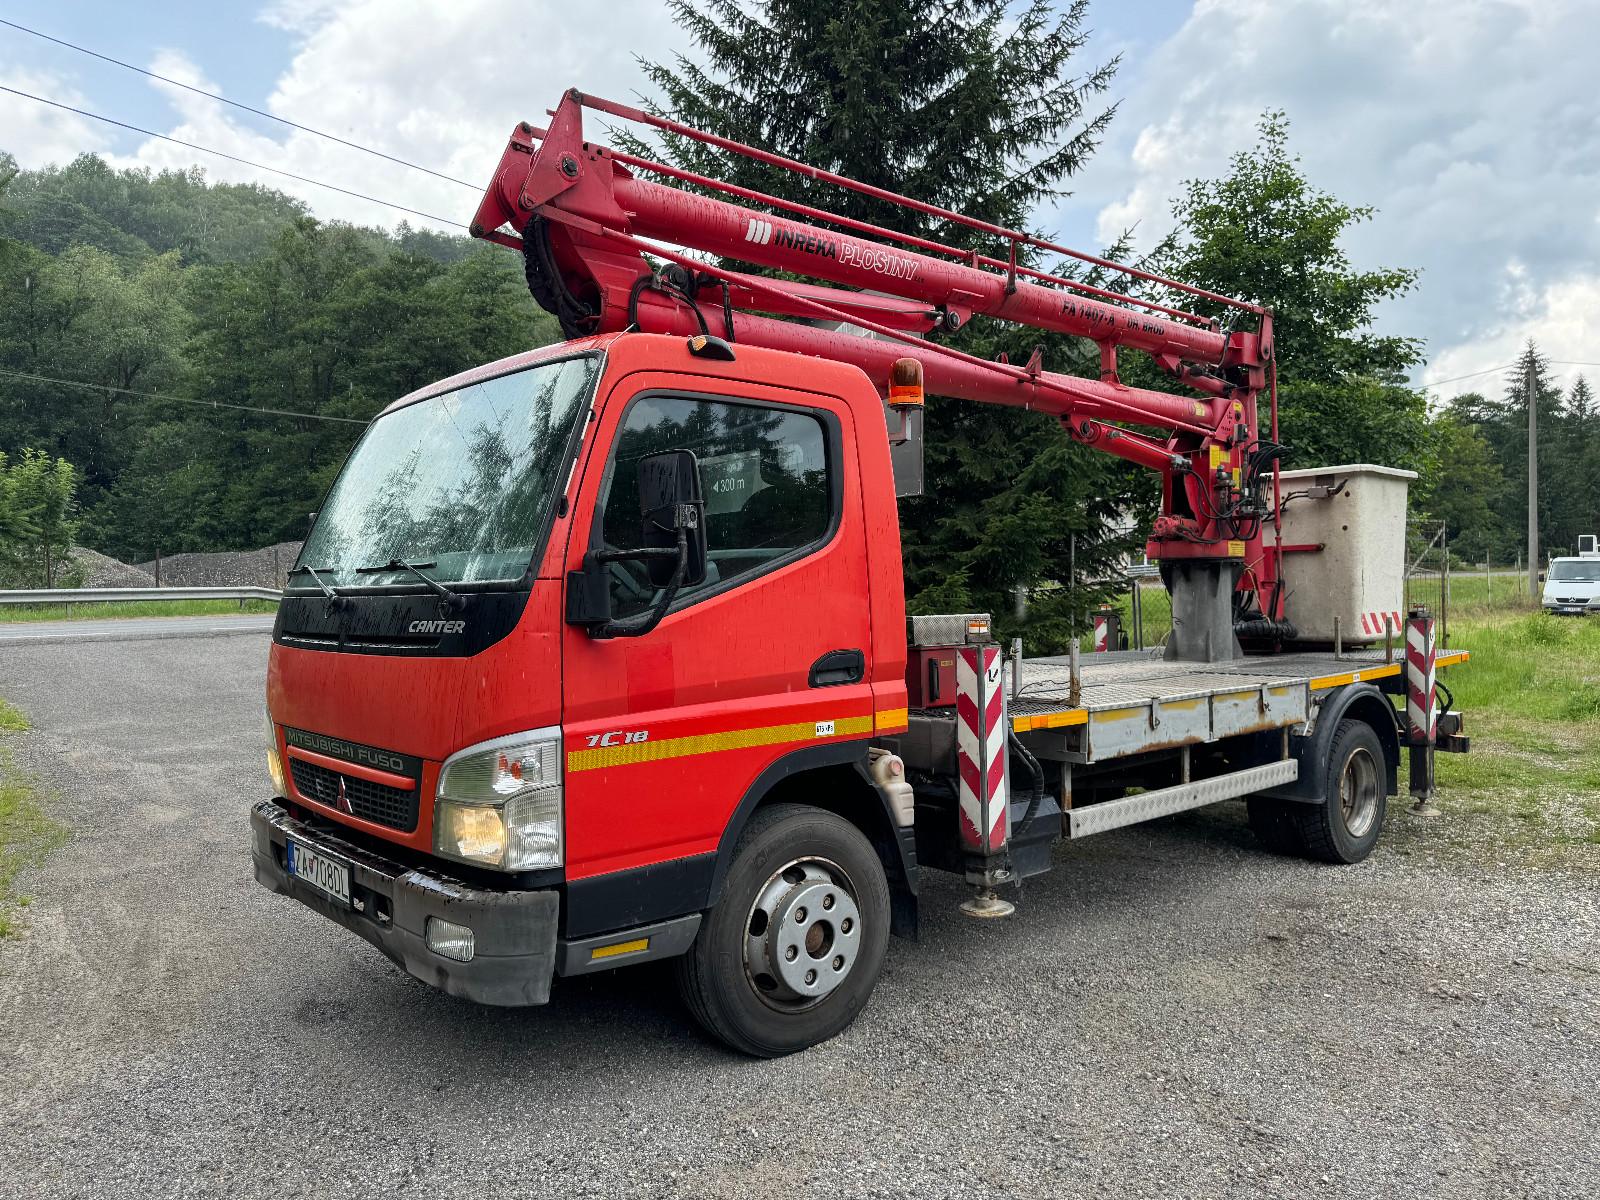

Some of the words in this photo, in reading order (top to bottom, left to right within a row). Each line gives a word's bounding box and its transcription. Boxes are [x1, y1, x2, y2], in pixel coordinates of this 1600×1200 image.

[774, 229, 836, 259] INREKA
[839, 243, 918, 280] PLOŠINY
[1062, 302, 1076, 317] FA
[1142, 322, 1165, 336] BROD
[408, 620, 466, 634] CANTER
[288, 731, 354, 757] MITSUBISHI
[358, 749, 404, 771] FUSO
